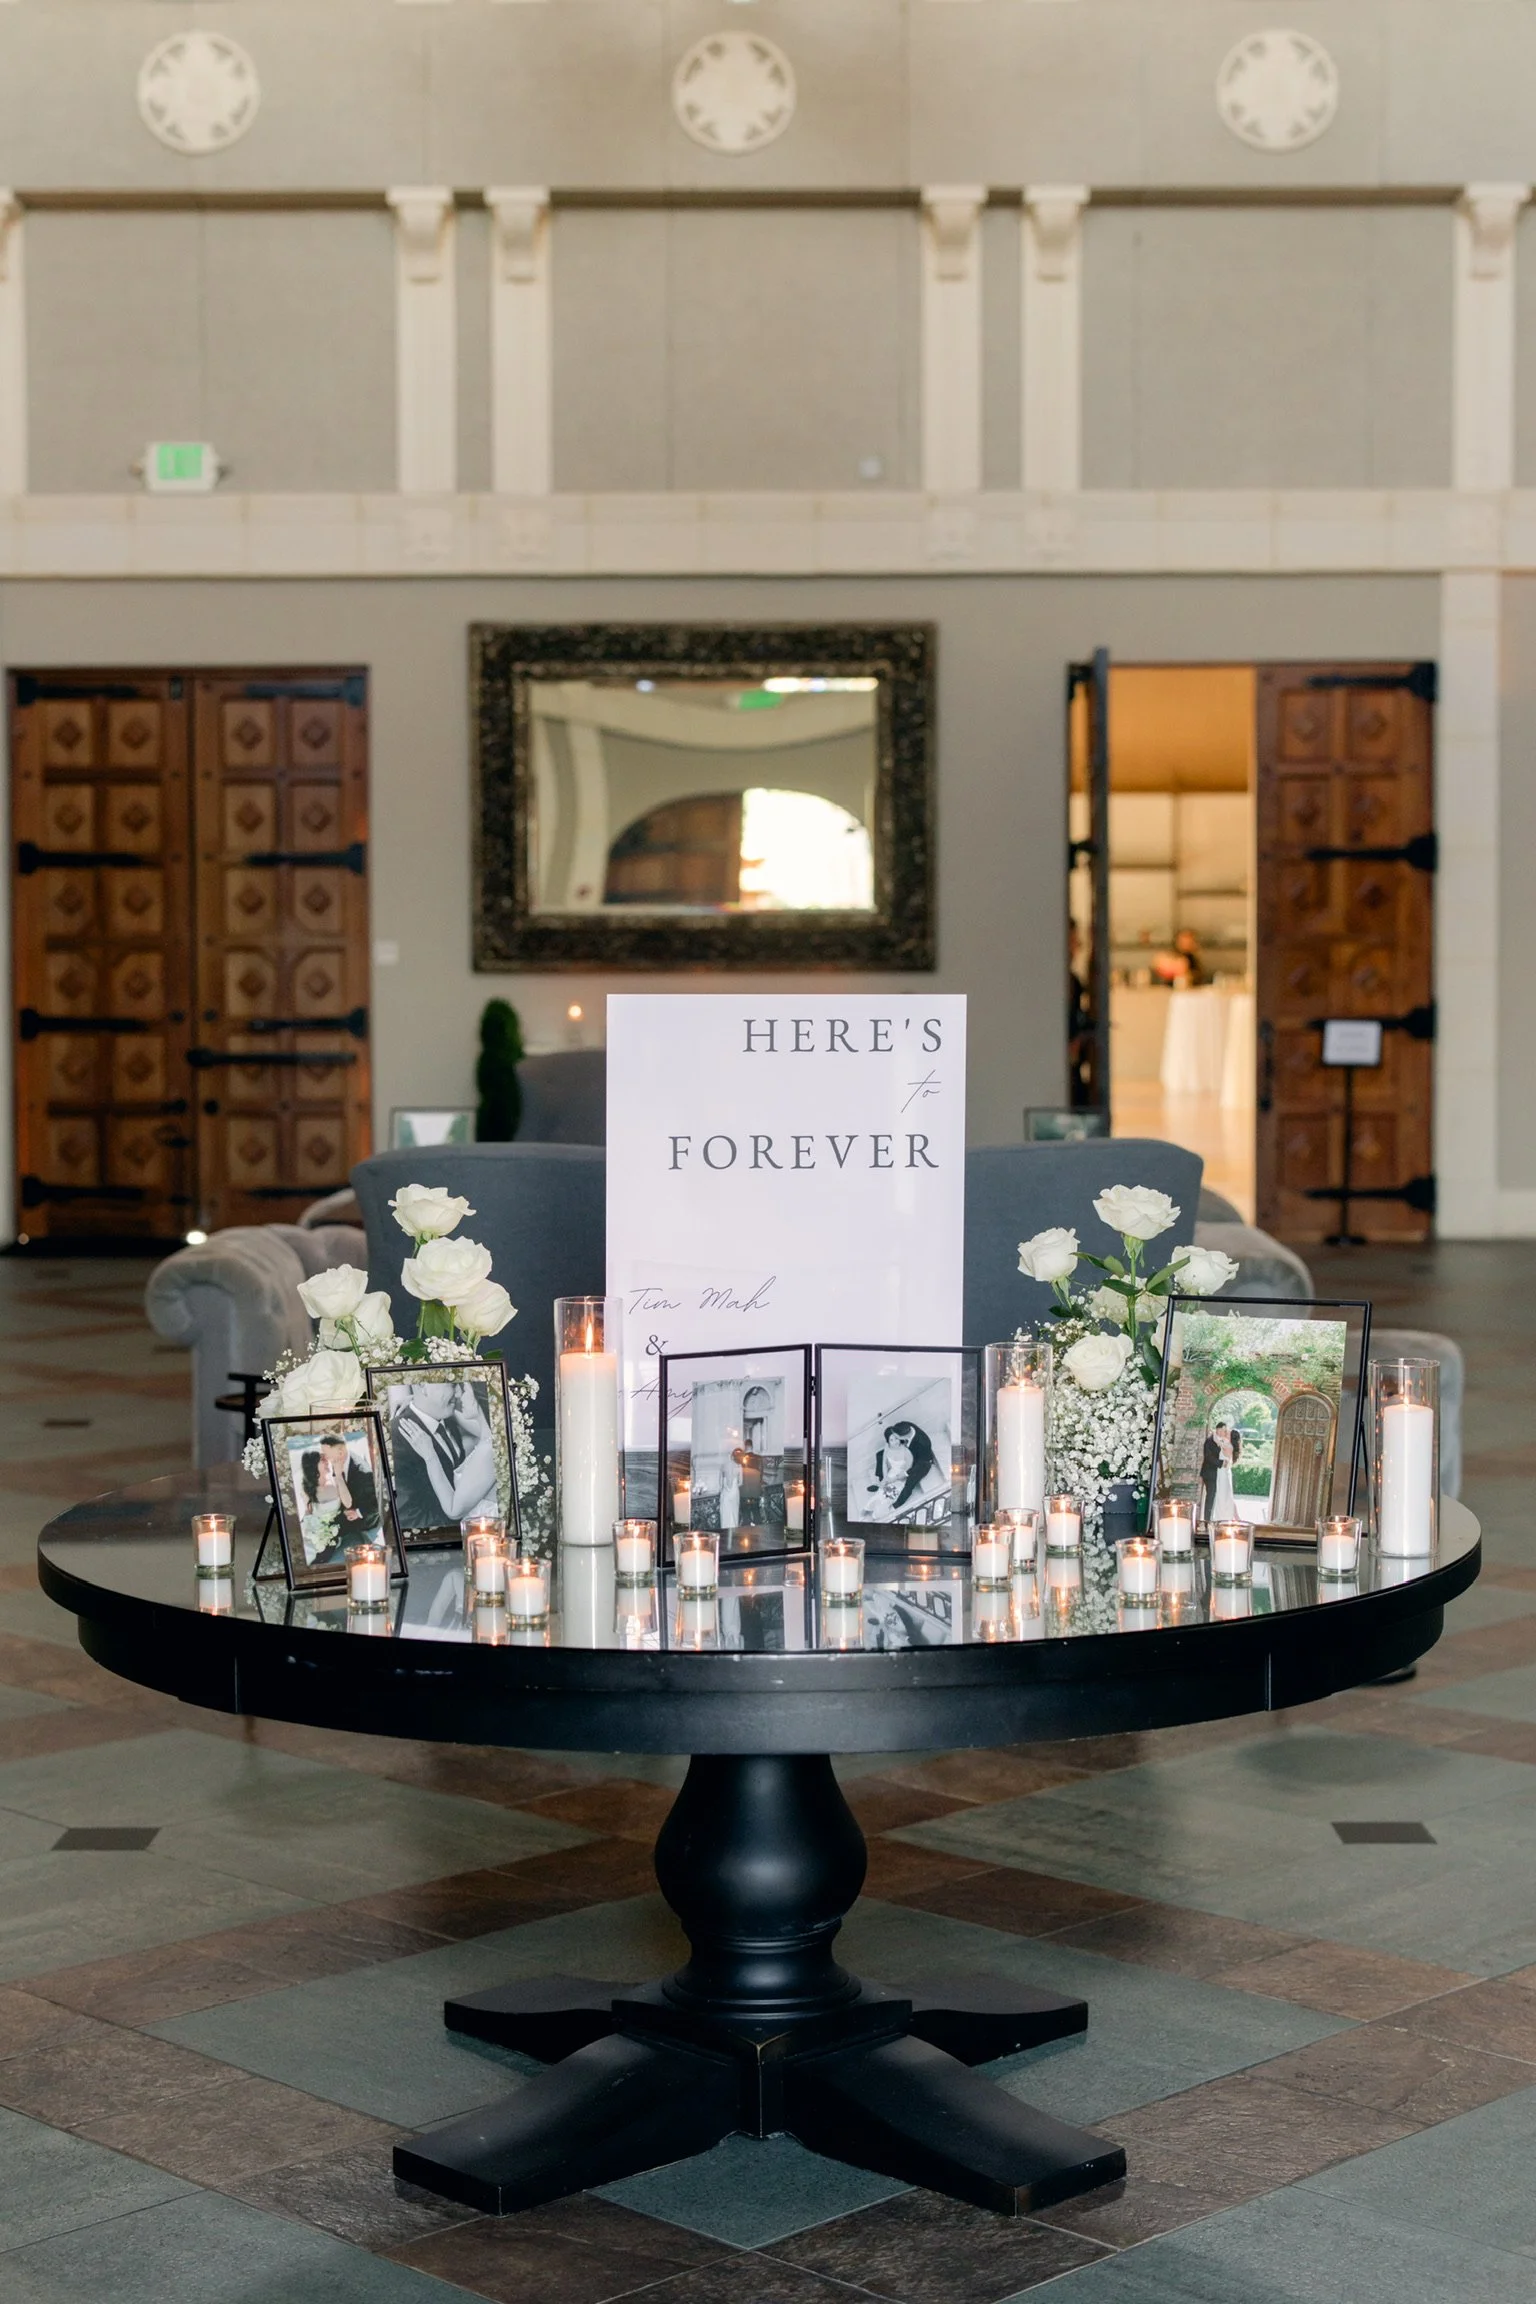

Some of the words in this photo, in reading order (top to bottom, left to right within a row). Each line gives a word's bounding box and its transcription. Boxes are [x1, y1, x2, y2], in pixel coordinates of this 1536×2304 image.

[742, 1017, 943, 1054] HERE'S
[901, 1069, 942, 1114] to
[667, 1133, 940, 1171] FOREVER
[628, 1287, 682, 1315] Tim
[698, 1275, 777, 1313] Mah
[645, 1334, 669, 1356] &
